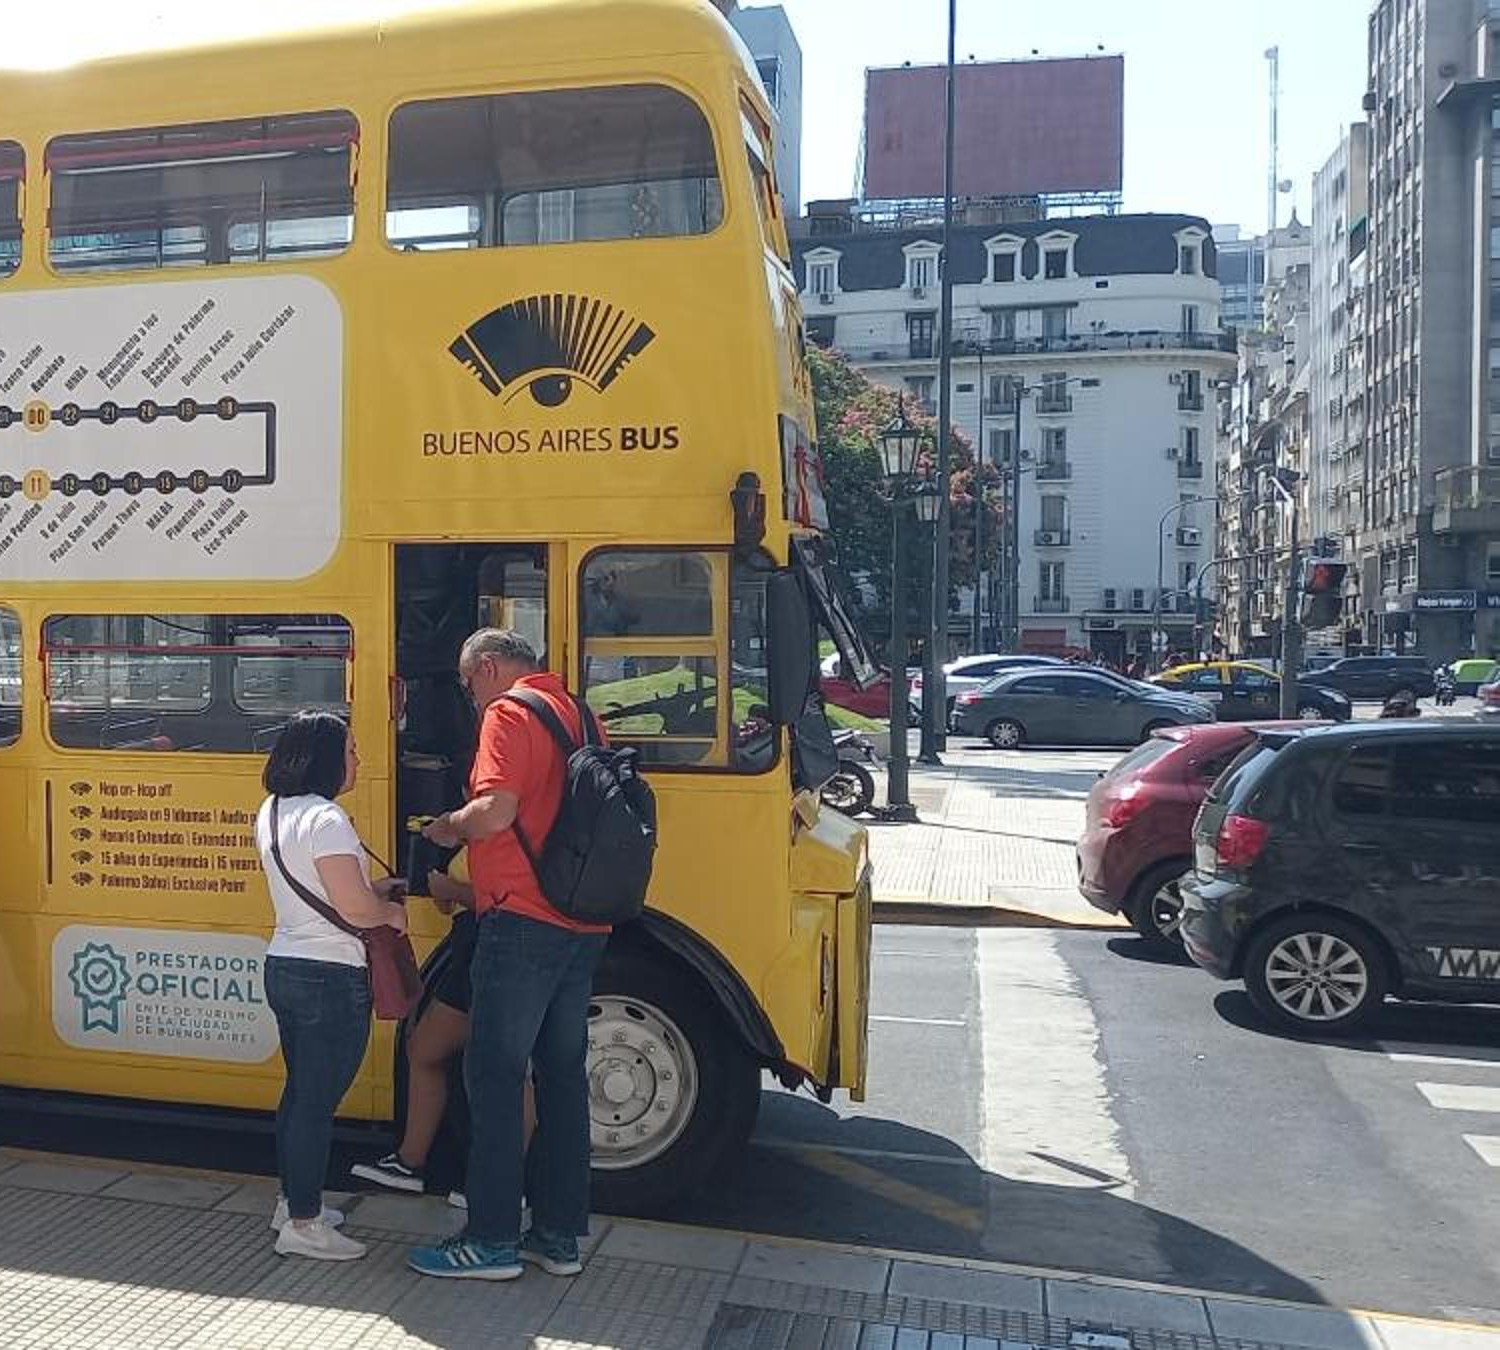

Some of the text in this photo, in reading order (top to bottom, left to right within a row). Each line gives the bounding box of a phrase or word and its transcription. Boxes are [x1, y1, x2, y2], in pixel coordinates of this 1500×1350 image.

[181, 299, 215, 334] Palermo
[30, 355, 65, 393] Recoleta
[220, 359, 245, 385] Plaza
[65, 406, 77, 421] 22
[103, 405, 115, 420] 21
[423, 426, 679, 456] BUENOS AIRES BUS
[31, 477, 42, 493] 11
[160, 476, 171, 490] 15
[193, 474, 205, 488] 16
[227, 474, 238, 488] 17
[146, 501, 174, 531] MALBA
[191, 497, 235, 542] Plaza Italia
[50, 539, 72, 563] Plaza
[68, 525, 85, 543] San
[92, 523, 120, 552] Parque
[100, 782, 118, 797] Hop
[137, 783, 156, 798] Hop
[158, 783, 173, 797] off
[150, 808, 162, 821] en
[164, 807, 171, 822] 9
[221, 809, 248, 825] Audio
[101, 829, 135, 844] Horario
[137, 830, 184, 845] Extendido
[192, 831, 237, 847] Extended
[101, 851, 111, 865] 15
[113, 852, 137, 868] años
[138, 852, 150, 867] de
[152, 854, 208, 870] Experiencia
[217, 855, 227, 870] 15
[230, 858, 257, 872] years
[101, 874, 141, 890] Palermo
[173, 876, 218, 893] Exclusive
[136, 951, 260, 973] PRESTADOR
[136, 972, 263, 1004] OFICIAL
[136, 1003, 257, 1021] ENTE DE TURISMO
[135, 1015, 230, 1031] DE LA CIUDAD
[135, 1025, 256, 1043] DE BUENOS AIRES
